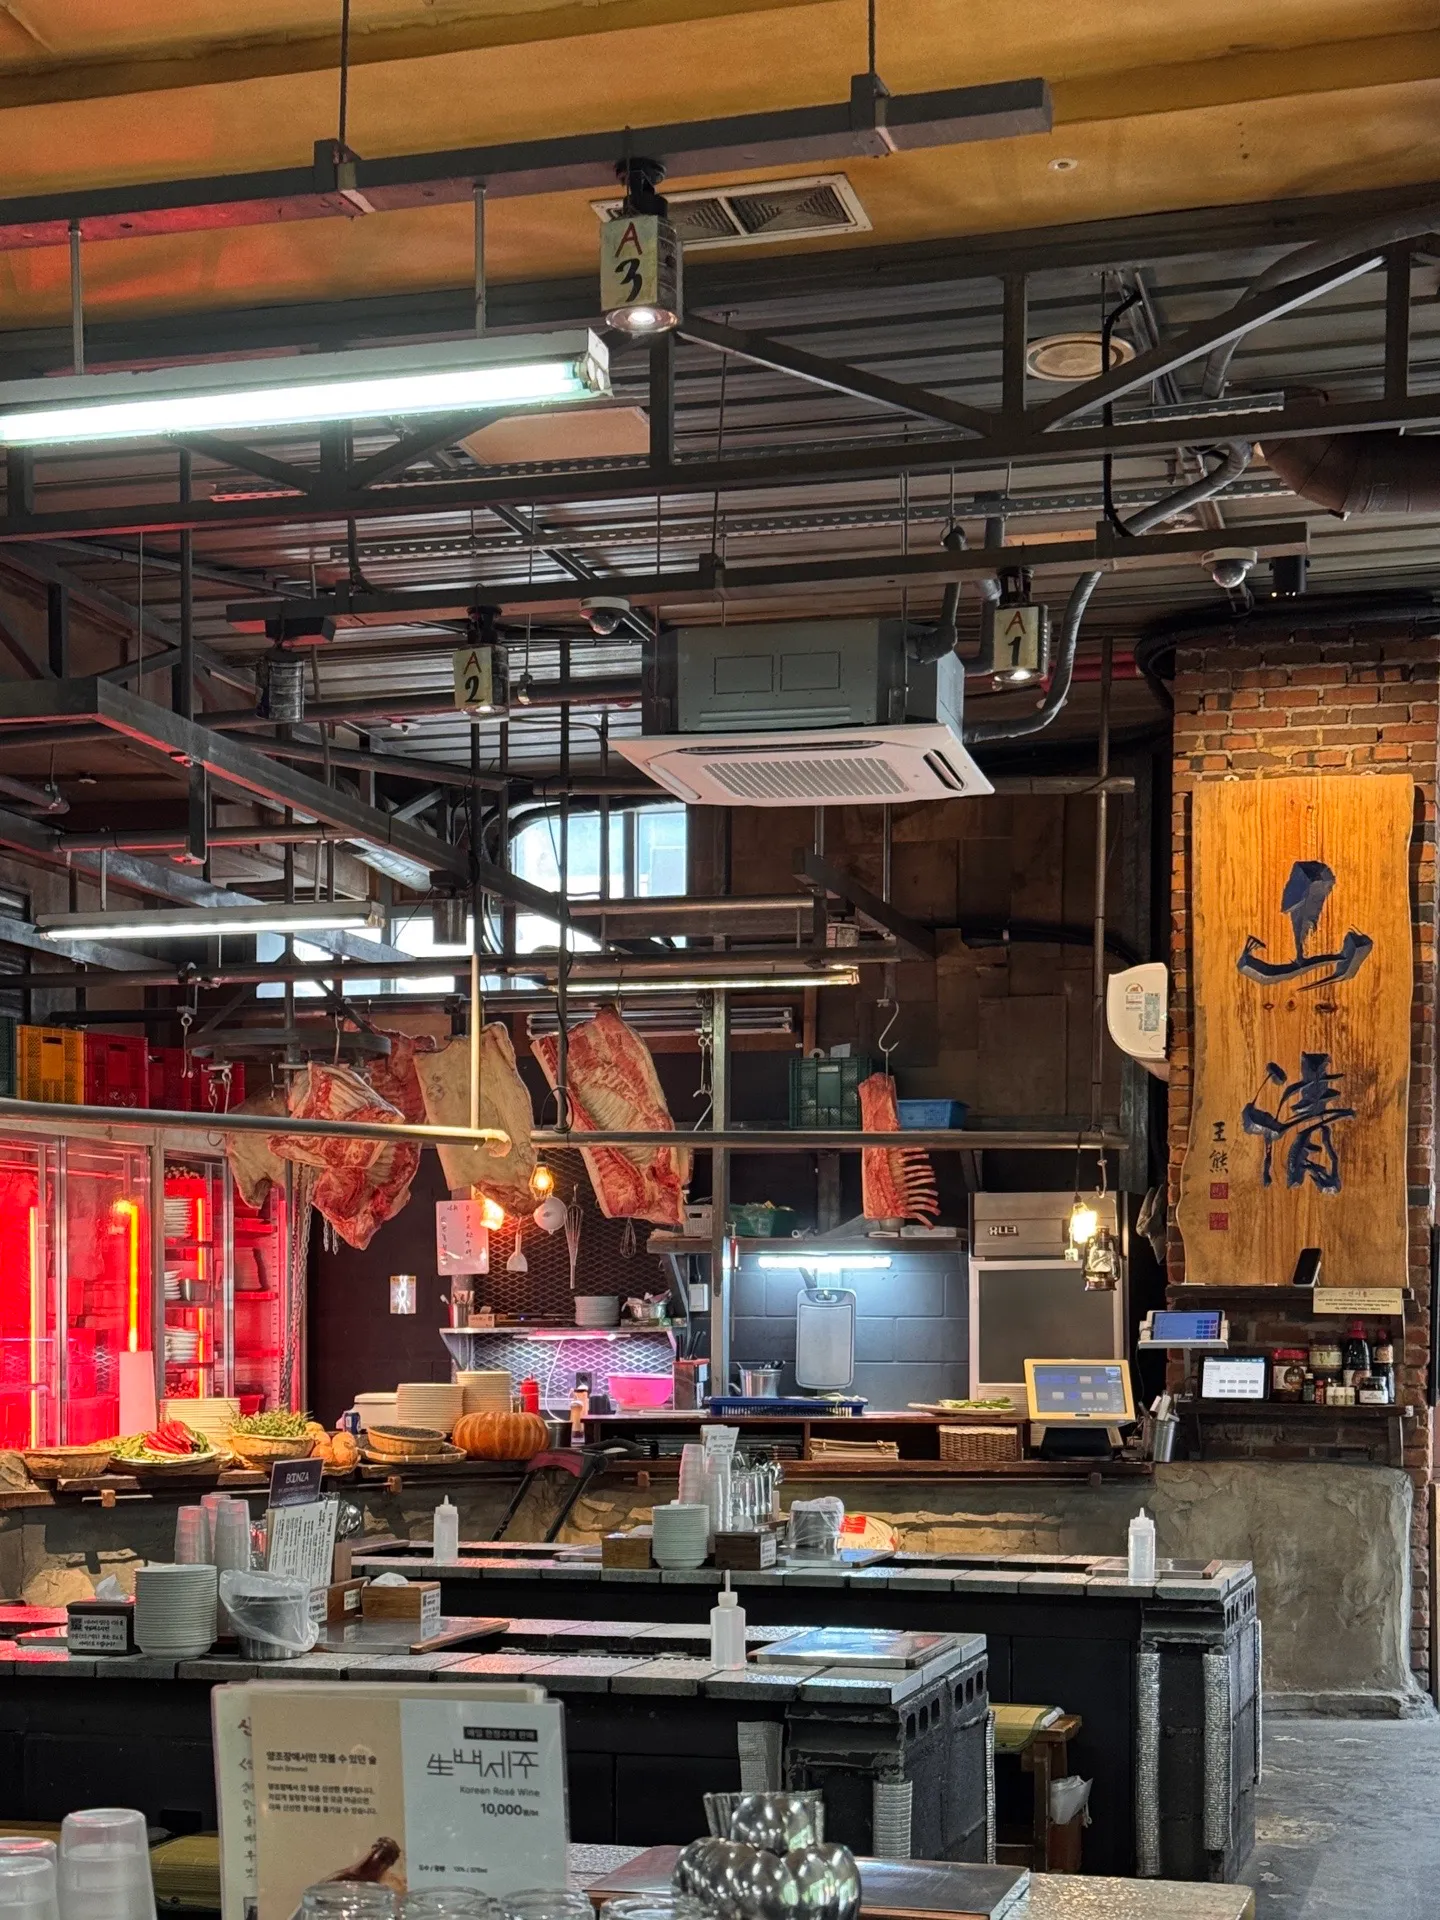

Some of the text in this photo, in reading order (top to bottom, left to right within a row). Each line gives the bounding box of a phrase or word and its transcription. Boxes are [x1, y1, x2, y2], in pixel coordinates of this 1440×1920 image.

[614, 221, 642, 258] A
[614, 258, 642, 303] 3
[1004, 610, 1026, 636] A
[463, 651, 482, 675] A
[1007, 636, 1022, 667] 1
[464, 675, 485, 703] 2
[460, 1786, 491, 1796] Korean
[517, 1788, 541, 1798] Wine
